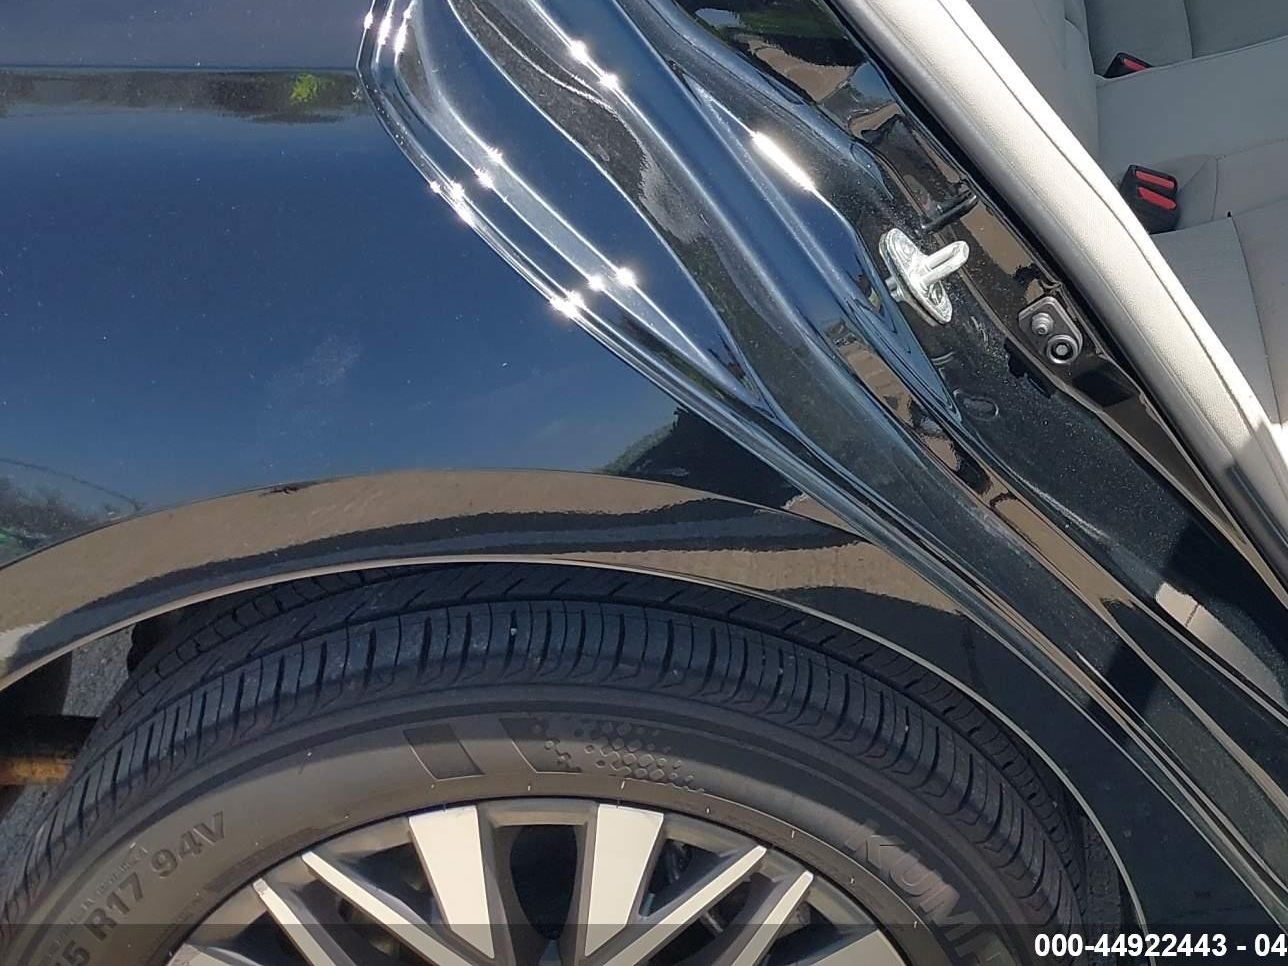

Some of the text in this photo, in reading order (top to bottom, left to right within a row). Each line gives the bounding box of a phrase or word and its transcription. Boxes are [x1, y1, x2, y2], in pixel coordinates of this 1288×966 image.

[83, 872, 144, 941] R17
[152, 811, 225, 879] 94V
[844, 818, 1017, 966] KUMH
